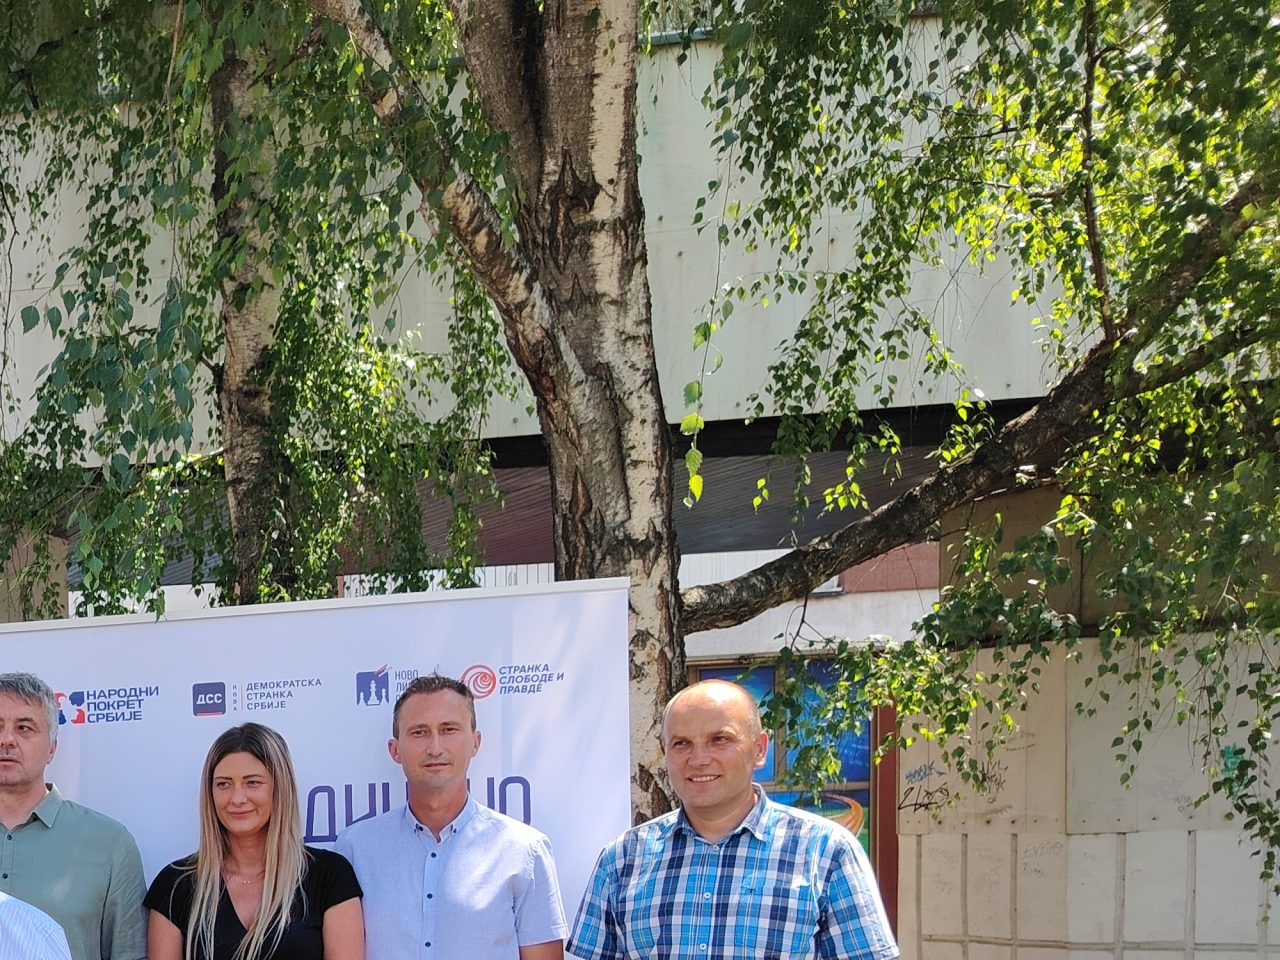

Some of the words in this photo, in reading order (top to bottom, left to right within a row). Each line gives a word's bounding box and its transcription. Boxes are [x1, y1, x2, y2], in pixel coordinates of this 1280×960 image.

[394, 669, 419, 681] НОВО
[499, 664, 550, 675] СТРАНКА
[246, 678, 322, 692] ДЕМОКРАТСКА
[499, 674, 554, 685] СЛОБОДЕ
[556, 673, 565, 682] И
[86, 686, 160, 700] НАРОДНИ
[246, 690, 294, 701] СТРАНКА
[499, 684, 543, 695] ПРАВДЕ
[86, 698, 145, 712] ПОКРЕТ
[196, 693, 223, 705] ДСС
[246, 700, 287, 711] СРБИЈЕ
[86, 710, 143, 724] СРБИЈЕ
